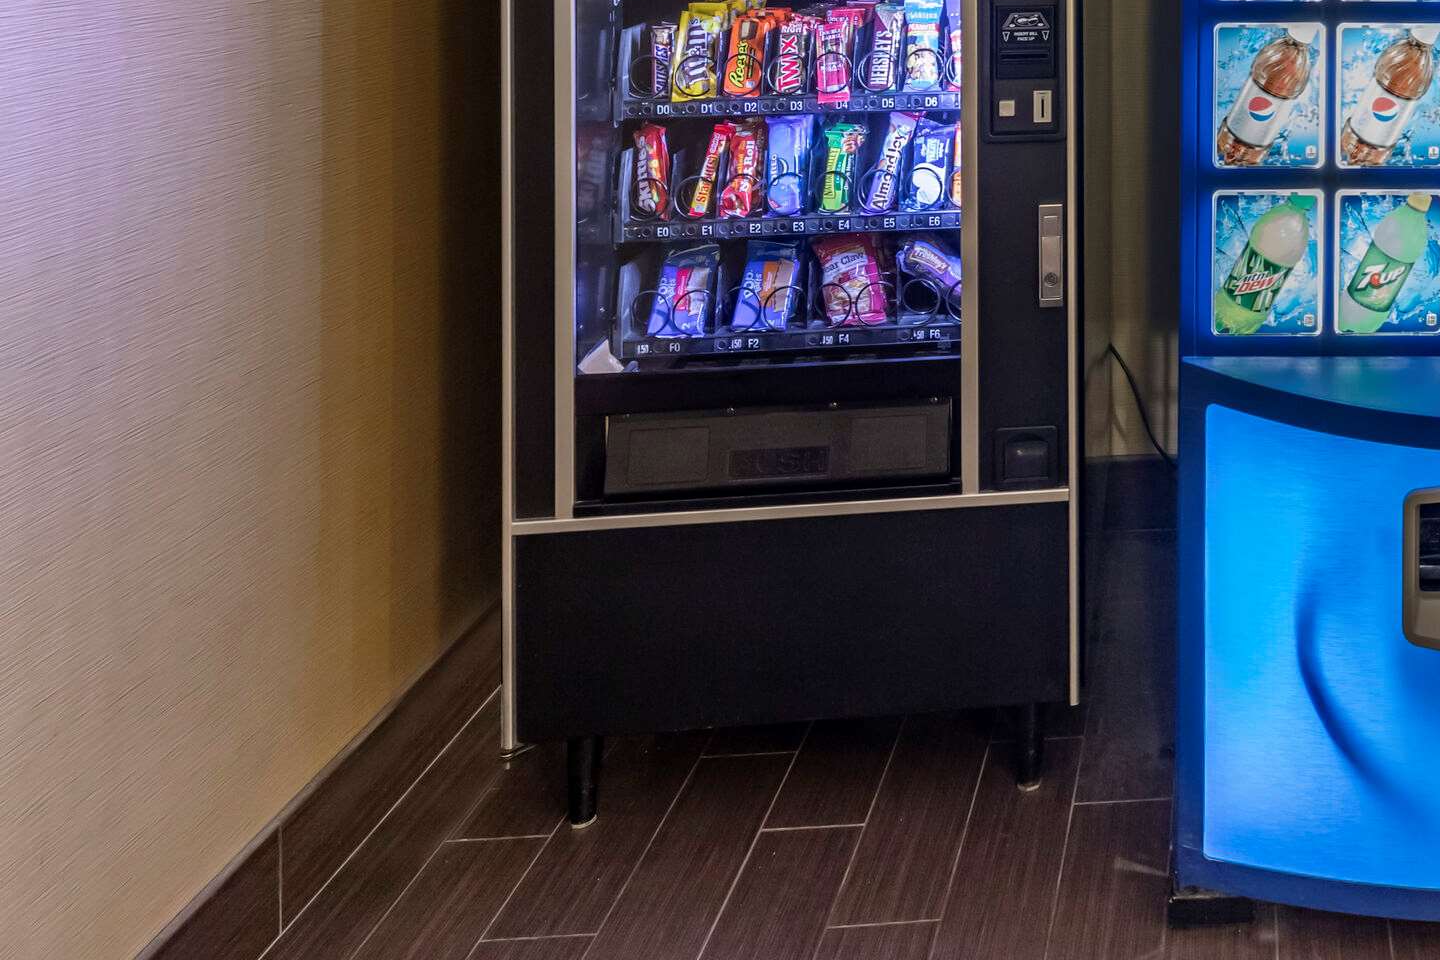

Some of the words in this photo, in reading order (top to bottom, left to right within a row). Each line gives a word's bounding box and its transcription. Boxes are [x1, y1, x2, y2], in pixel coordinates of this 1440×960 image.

[790, 101, 802, 111] D3
[882, 99, 894, 108] D5
[925, 97, 937, 106] D6
[657, 104, 670, 114] D0
[701, 103, 713, 113] D1
[745, 102, 757, 112] D2
[792, 221, 804, 231] E3
[839, 220, 849, 229] E4
[883, 218, 895, 228] E5
[929, 216, 940, 226] E6
[657, 227, 669, 237] E0
[702, 225, 713, 235] E1
[750, 224, 761, 233] E2
[840, 253, 864, 265] Claw
[839, 334, 849, 344] F4
[930, 329, 941, 339] F6
[670, 343, 681, 352] F0
[748, 339, 759, 348] F2
